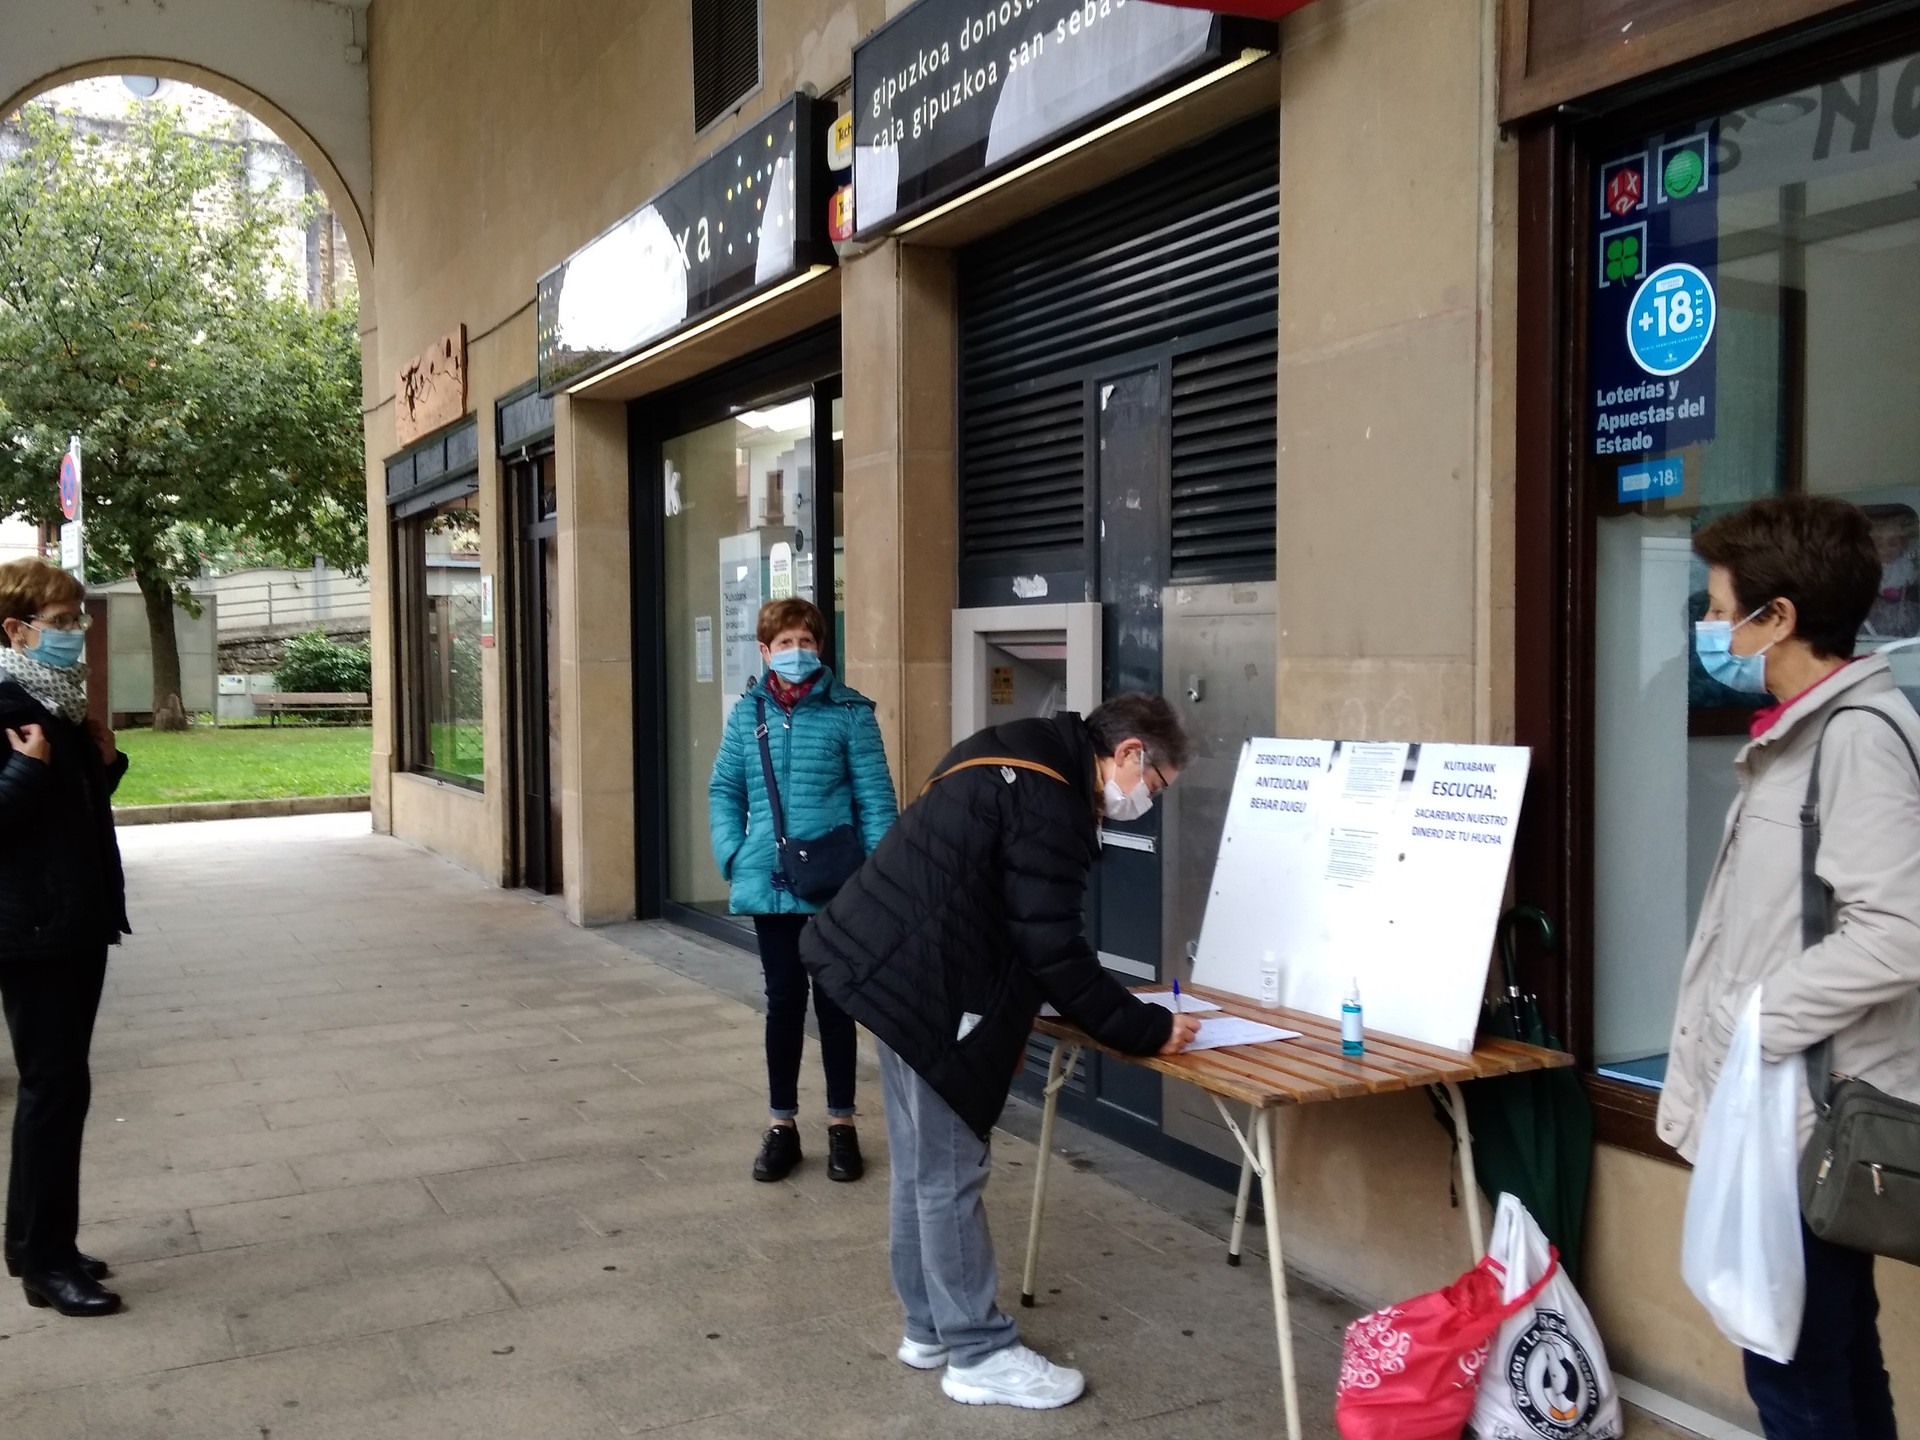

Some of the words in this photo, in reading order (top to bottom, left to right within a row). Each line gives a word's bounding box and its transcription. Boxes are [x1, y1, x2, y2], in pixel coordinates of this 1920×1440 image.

[872, 42, 950, 117] gipuzkoa
[960, 0, 1040, 51] donos
[872, 118, 904, 154] caja
[912, 61, 998, 140] gipuzkoa
[1008, 32, 1044, 73] san
[1638, 290, 1694, 337] +18
[1695, 288, 1704, 328] URTE
[1597, 380, 1665, 408] Loterías
[1669, 380, 1680, 400] y
[1597, 406, 1676, 434] Apuestas
[1677, 397, 1706, 419] del
[1596, 431, 1653, 456] Estado
[1255, 754, 1295, 767] ZERBITZU
[1295, 756, 1321, 768] OSOA
[1443, 760, 1496, 773] KUTXABANK
[1255, 776, 1309, 791] ANTZUOLAN
[1432, 781, 1498, 800] ESCUCHA:
[1250, 797, 1278, 811] BEHAR
[1279, 799, 1306, 813] DUGU
[1414, 808, 1465, 823] SACAREMOS
[1466, 812, 1508, 826] NUESTRO
[1412, 826, 1442, 839] DINERO
[1442, 829, 1455, 841] DE
[1457, 831, 1470, 842] TU
[1471, 832, 1502, 845] HUCHA
